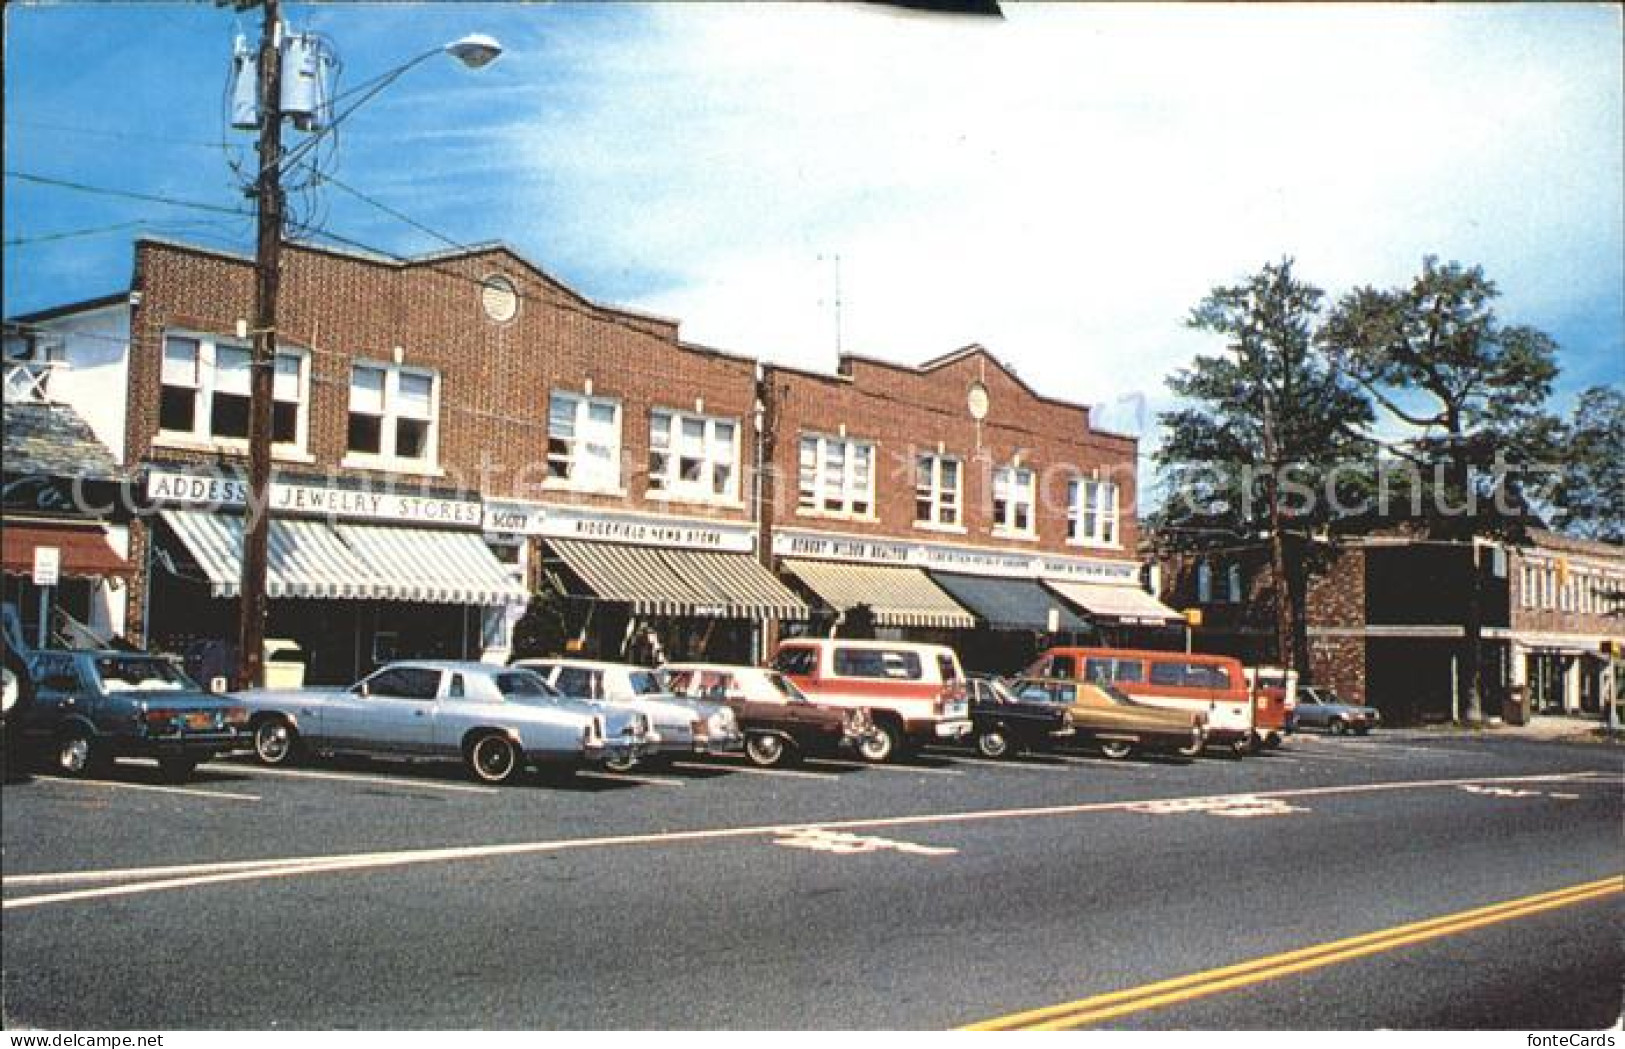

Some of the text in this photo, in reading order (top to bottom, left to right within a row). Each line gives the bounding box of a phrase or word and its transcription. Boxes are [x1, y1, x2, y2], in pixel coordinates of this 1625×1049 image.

[278, 487, 382, 513] JEWELRY
[398, 497, 475, 522] STORES
[575, 519, 721, 545] RIDGEFIELD NEWS STORE
